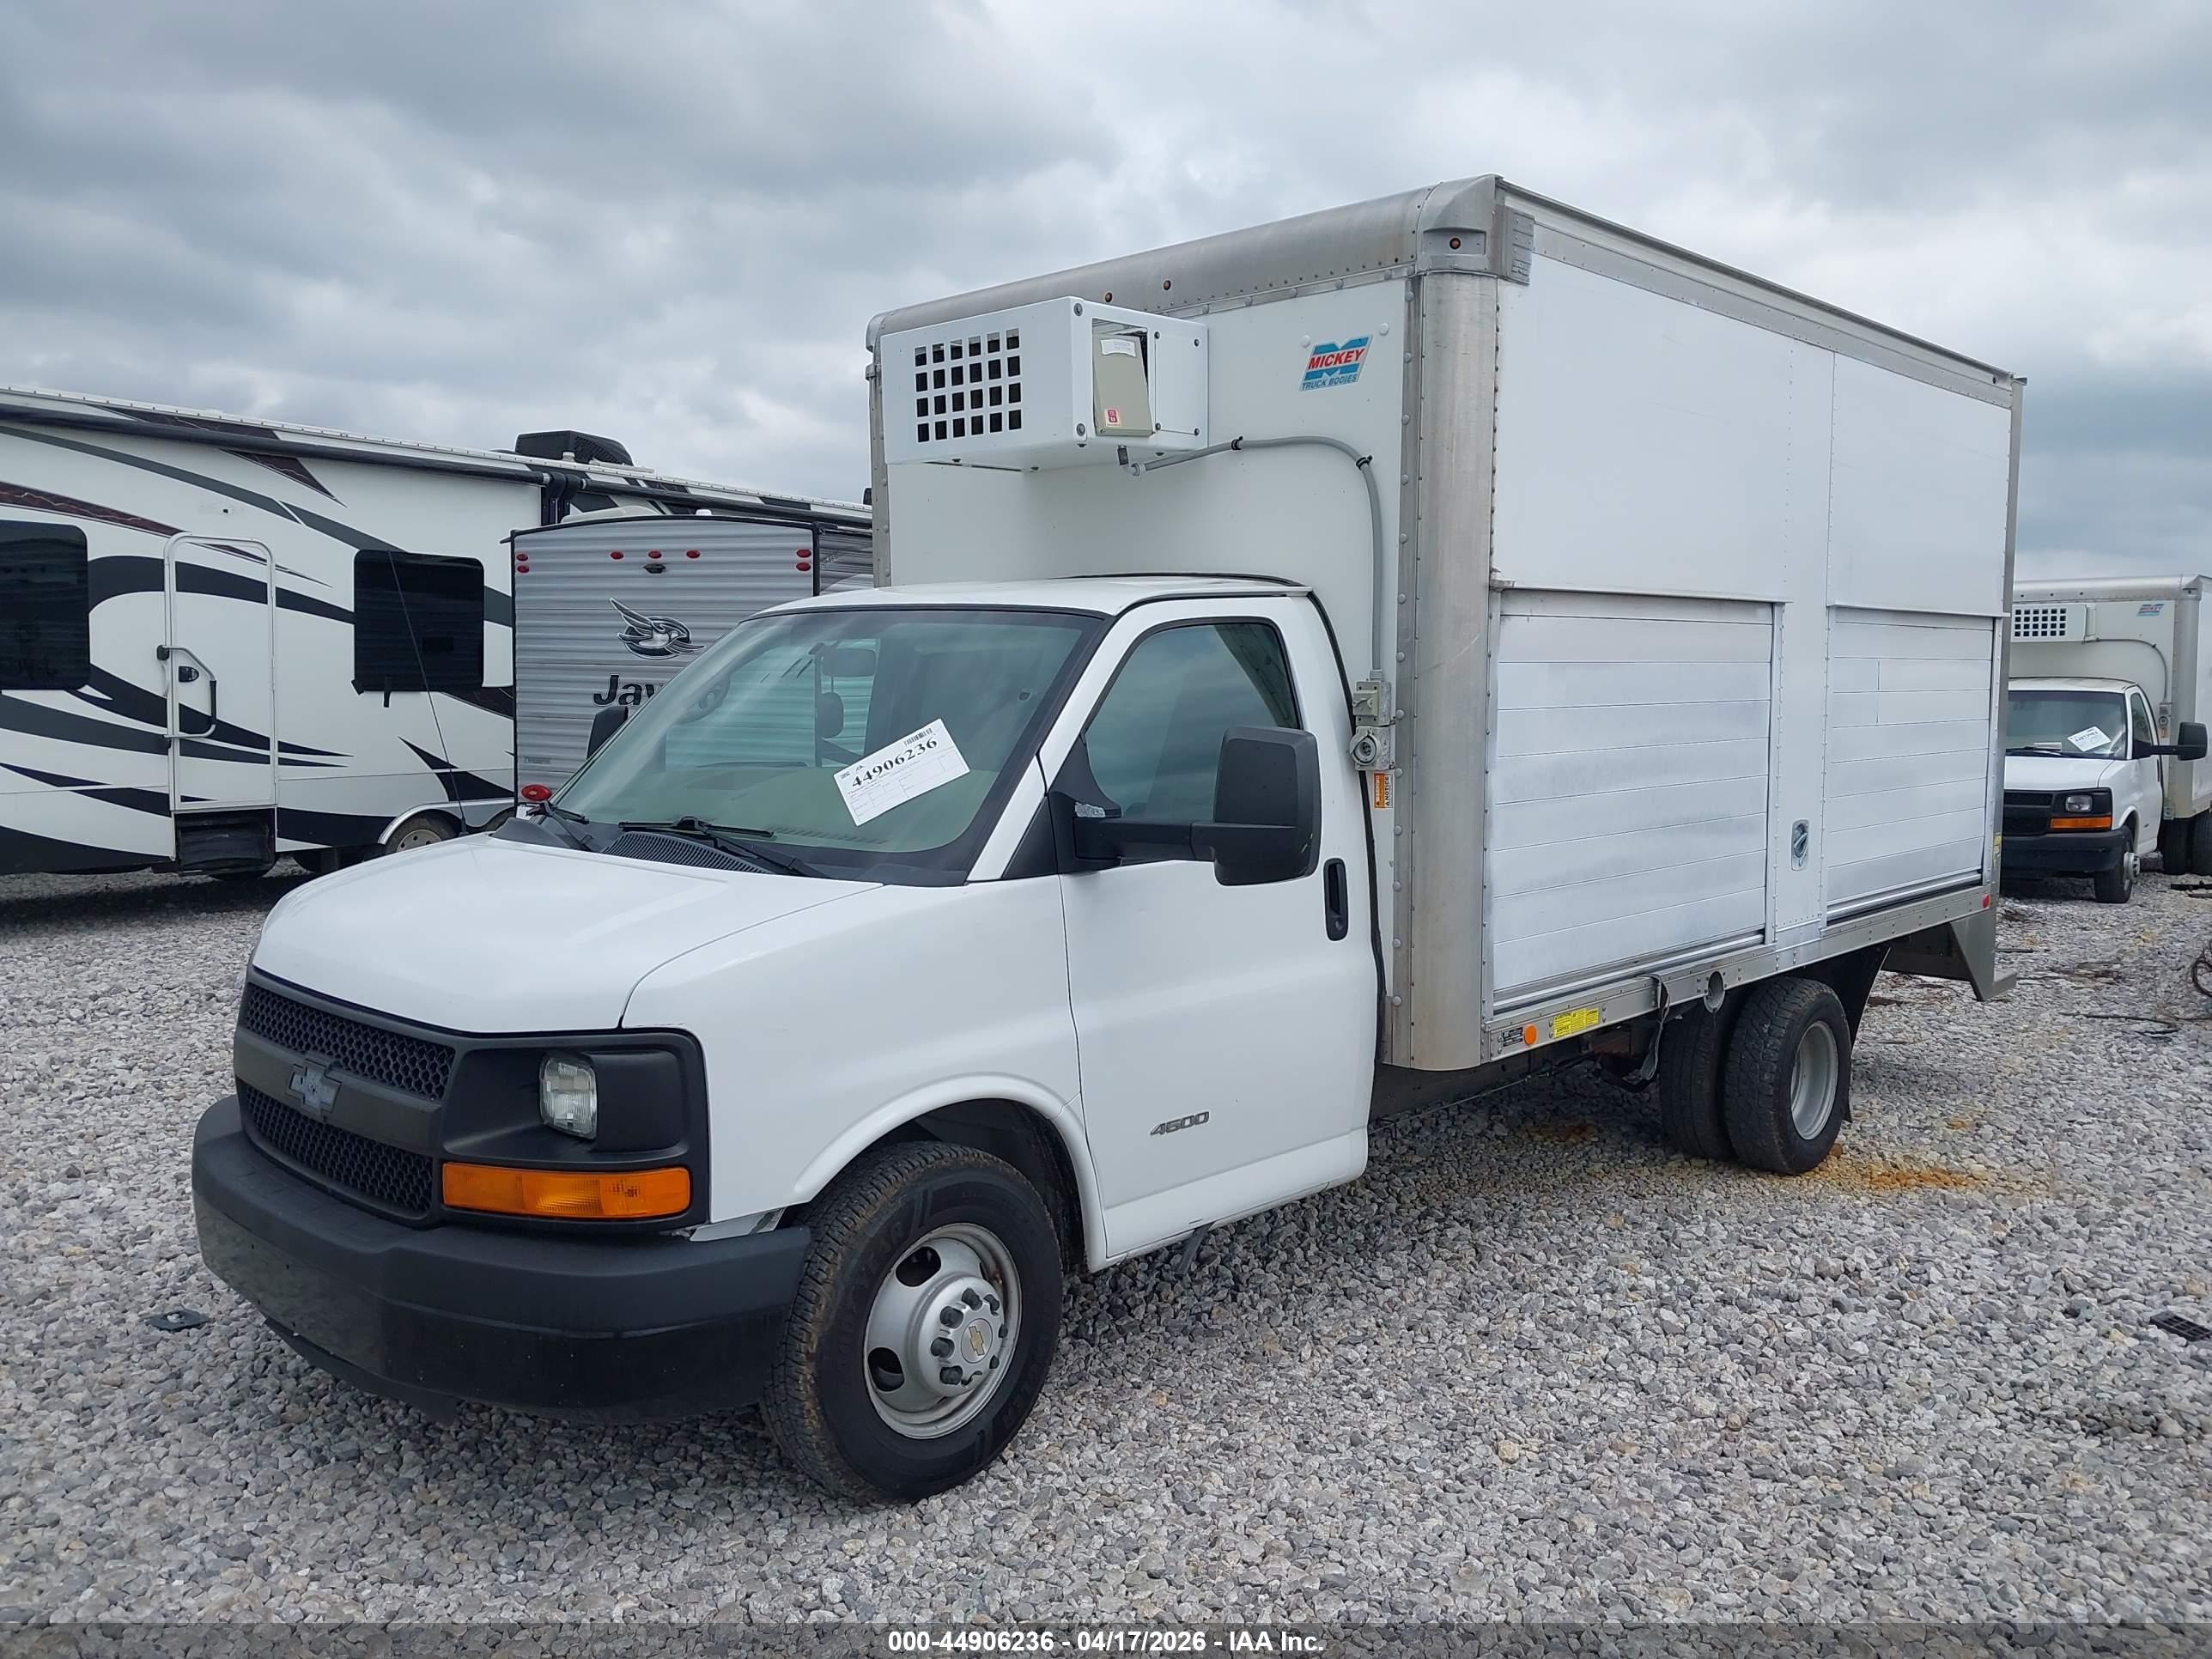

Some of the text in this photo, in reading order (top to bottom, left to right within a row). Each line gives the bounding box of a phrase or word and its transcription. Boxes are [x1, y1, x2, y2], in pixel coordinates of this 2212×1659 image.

[1307, 349, 1365, 370] MICKEY
[1302, 374, 1358, 391] TRUCK BODIES
[851, 737, 938, 788] 44906236
